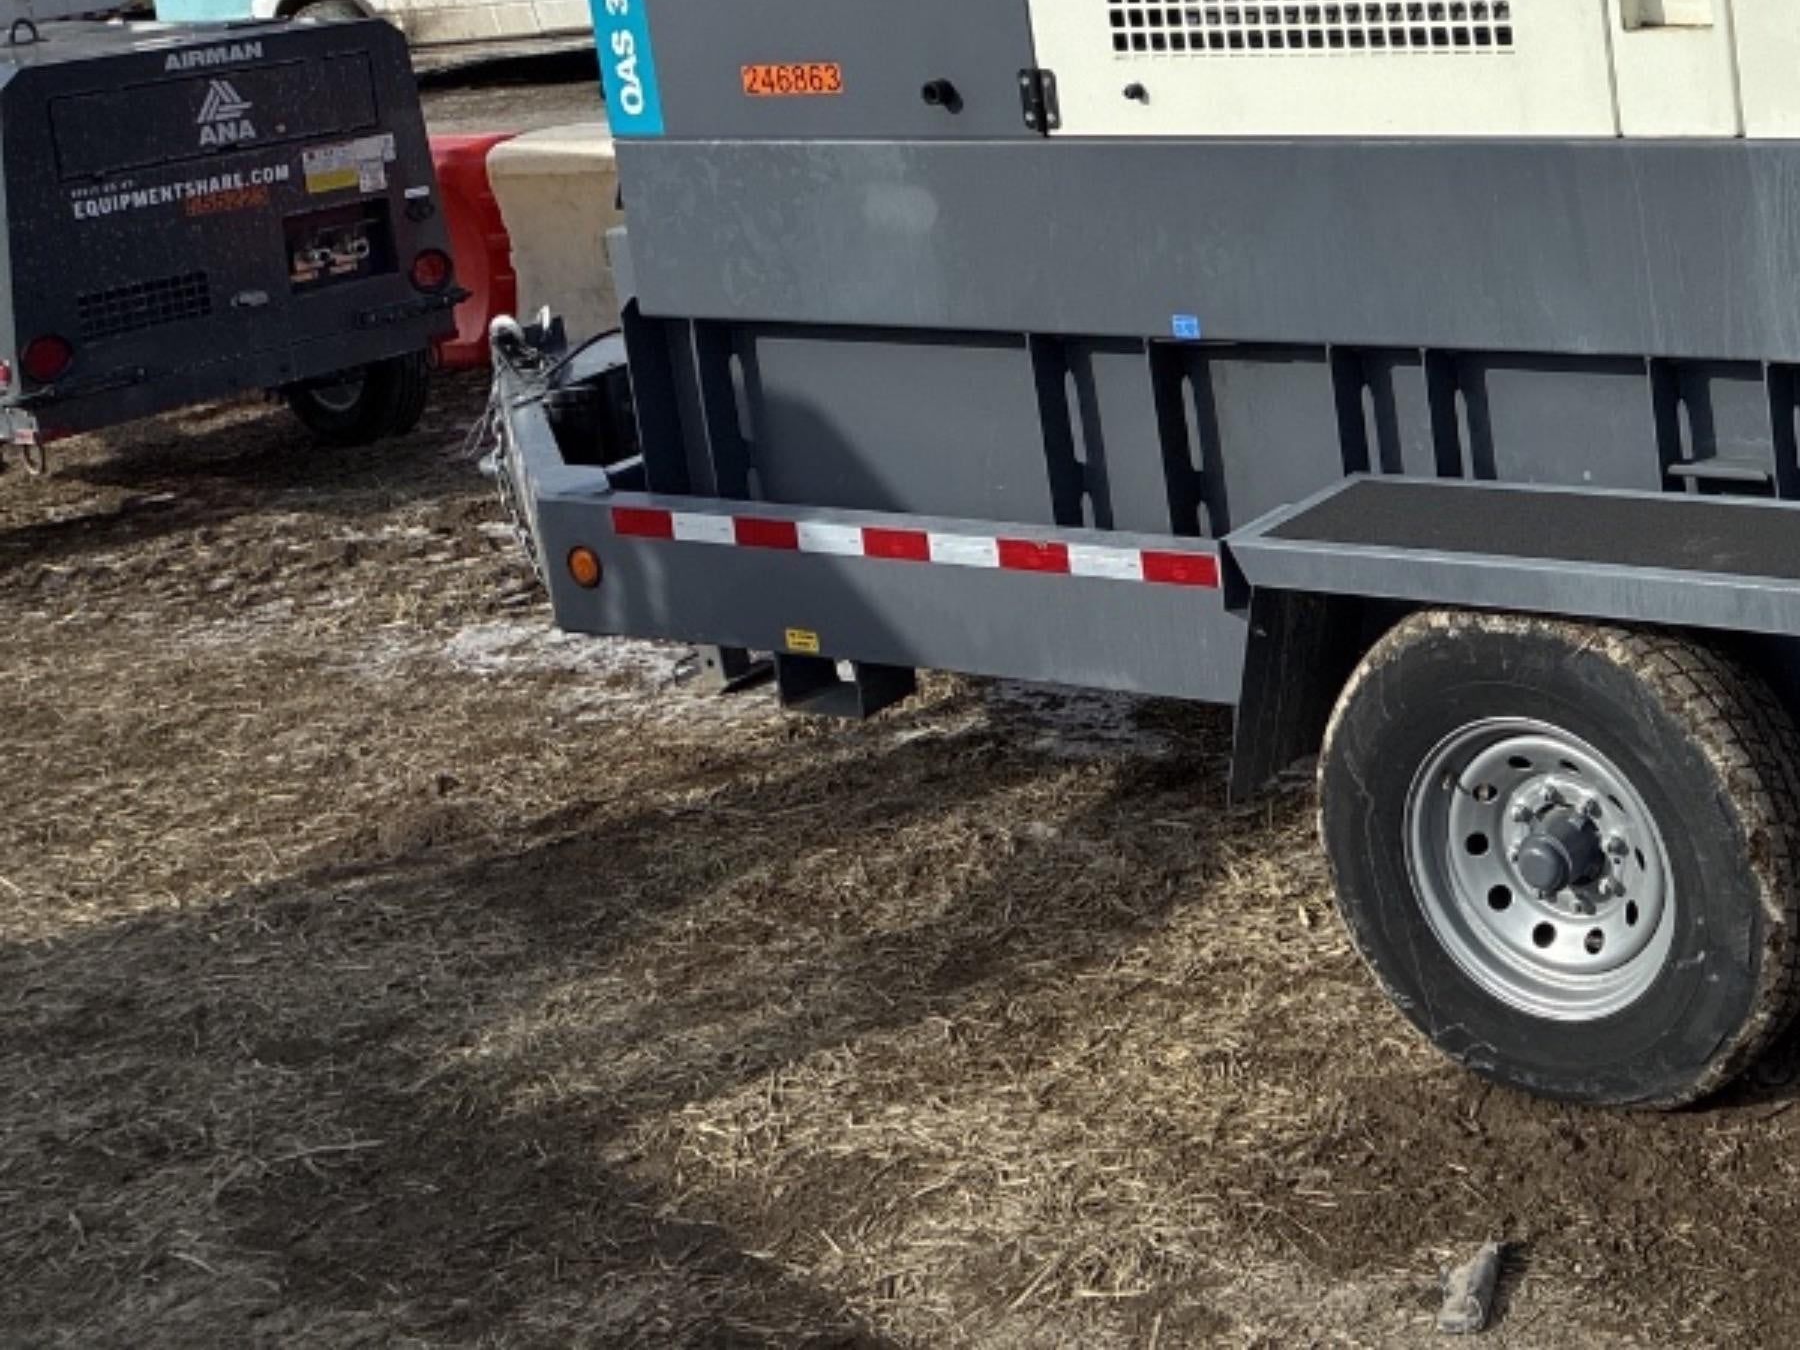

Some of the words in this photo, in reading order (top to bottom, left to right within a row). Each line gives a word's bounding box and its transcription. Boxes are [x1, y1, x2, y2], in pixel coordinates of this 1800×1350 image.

[164, 41, 264, 71] AIRMAN
[744, 65, 842, 96] 246863
[198, 120, 258, 147] ANA
[73, 164, 290, 220] EQUIPMENTSHARE.COM
